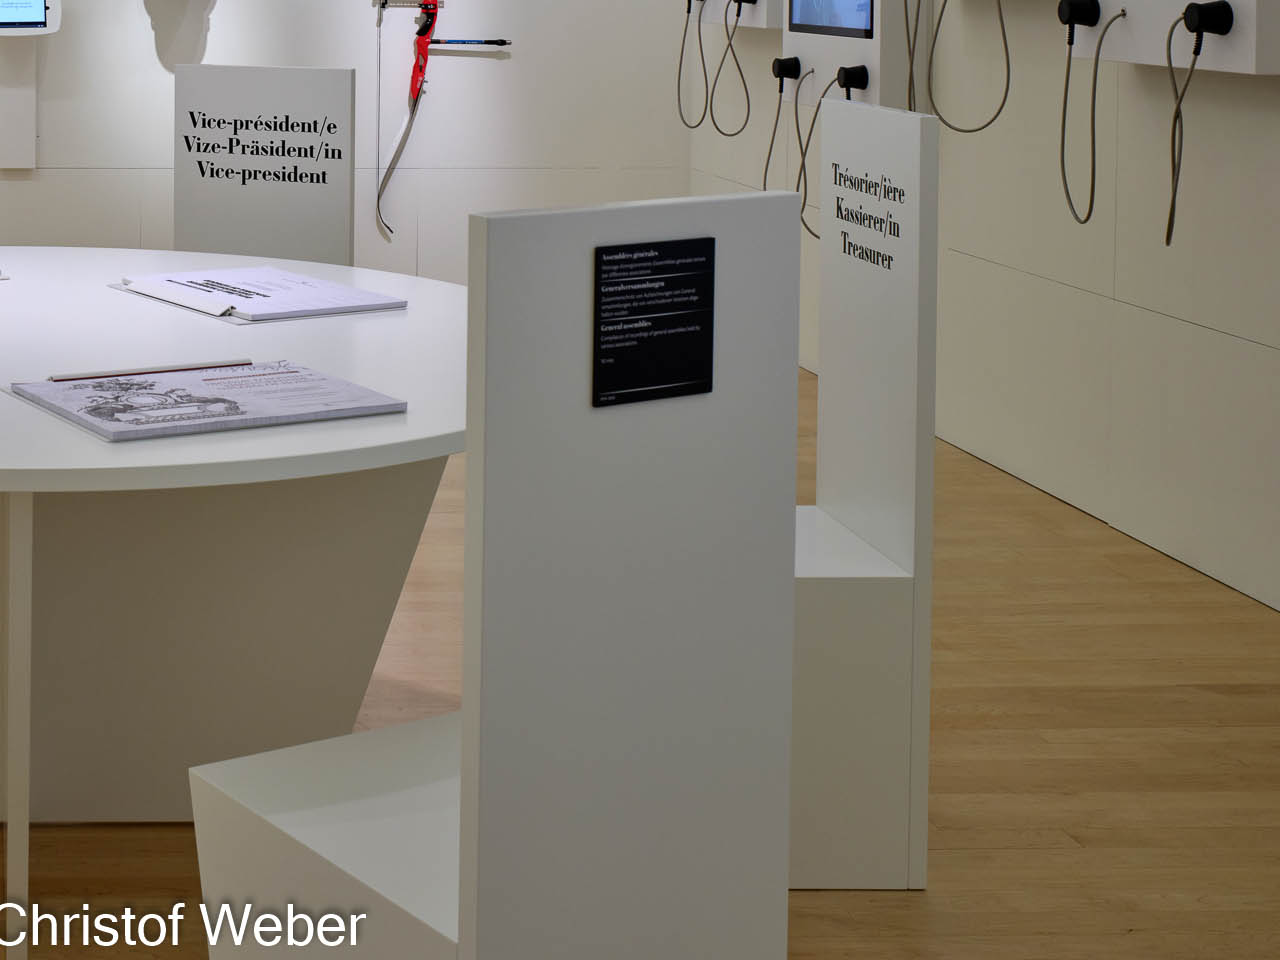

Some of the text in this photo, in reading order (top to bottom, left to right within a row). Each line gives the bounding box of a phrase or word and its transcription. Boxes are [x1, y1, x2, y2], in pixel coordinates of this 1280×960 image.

[188, 111, 338, 136] Vice-président/e
[184, 135, 342, 162] Vize-Präsident/in
[196, 160, 328, 186] Vice-president
[832, 162, 905, 204] Trésorier/ière
[836, 196, 900, 238] Kassierer/in
[841, 230, 894, 270] Treasurer
